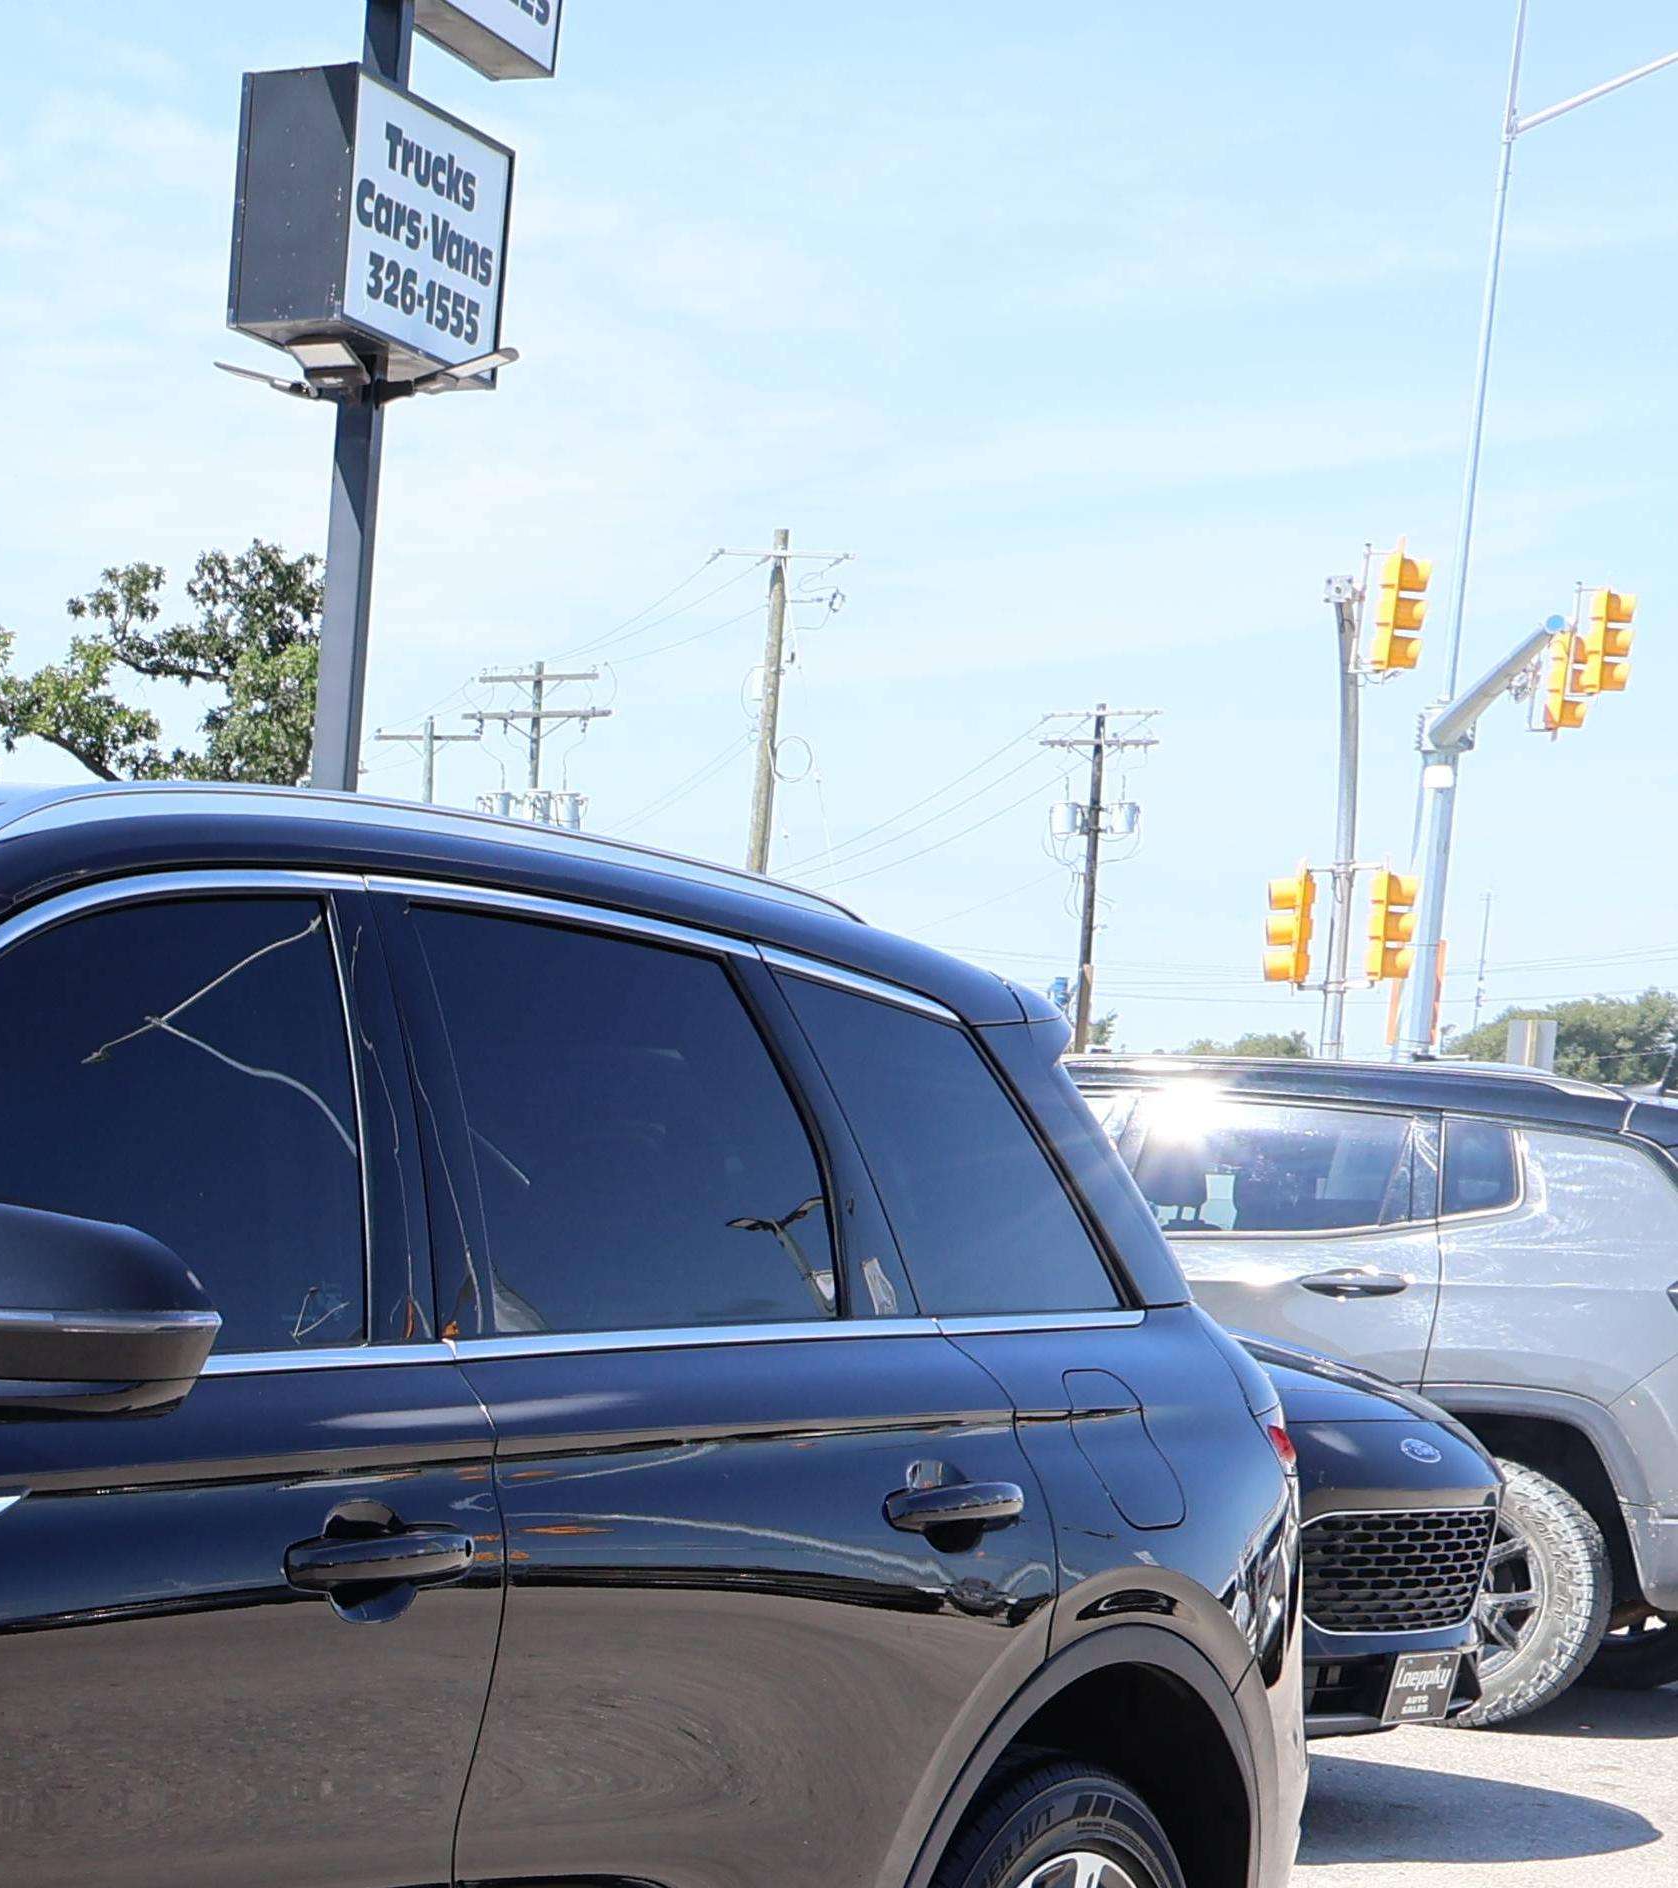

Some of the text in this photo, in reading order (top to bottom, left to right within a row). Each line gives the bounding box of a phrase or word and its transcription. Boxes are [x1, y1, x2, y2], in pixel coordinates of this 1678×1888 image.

[384, 121, 477, 212] Trucks
[366, 251, 481, 346] 326-1555
[1395, 1663, 1452, 1691] Loeppky
